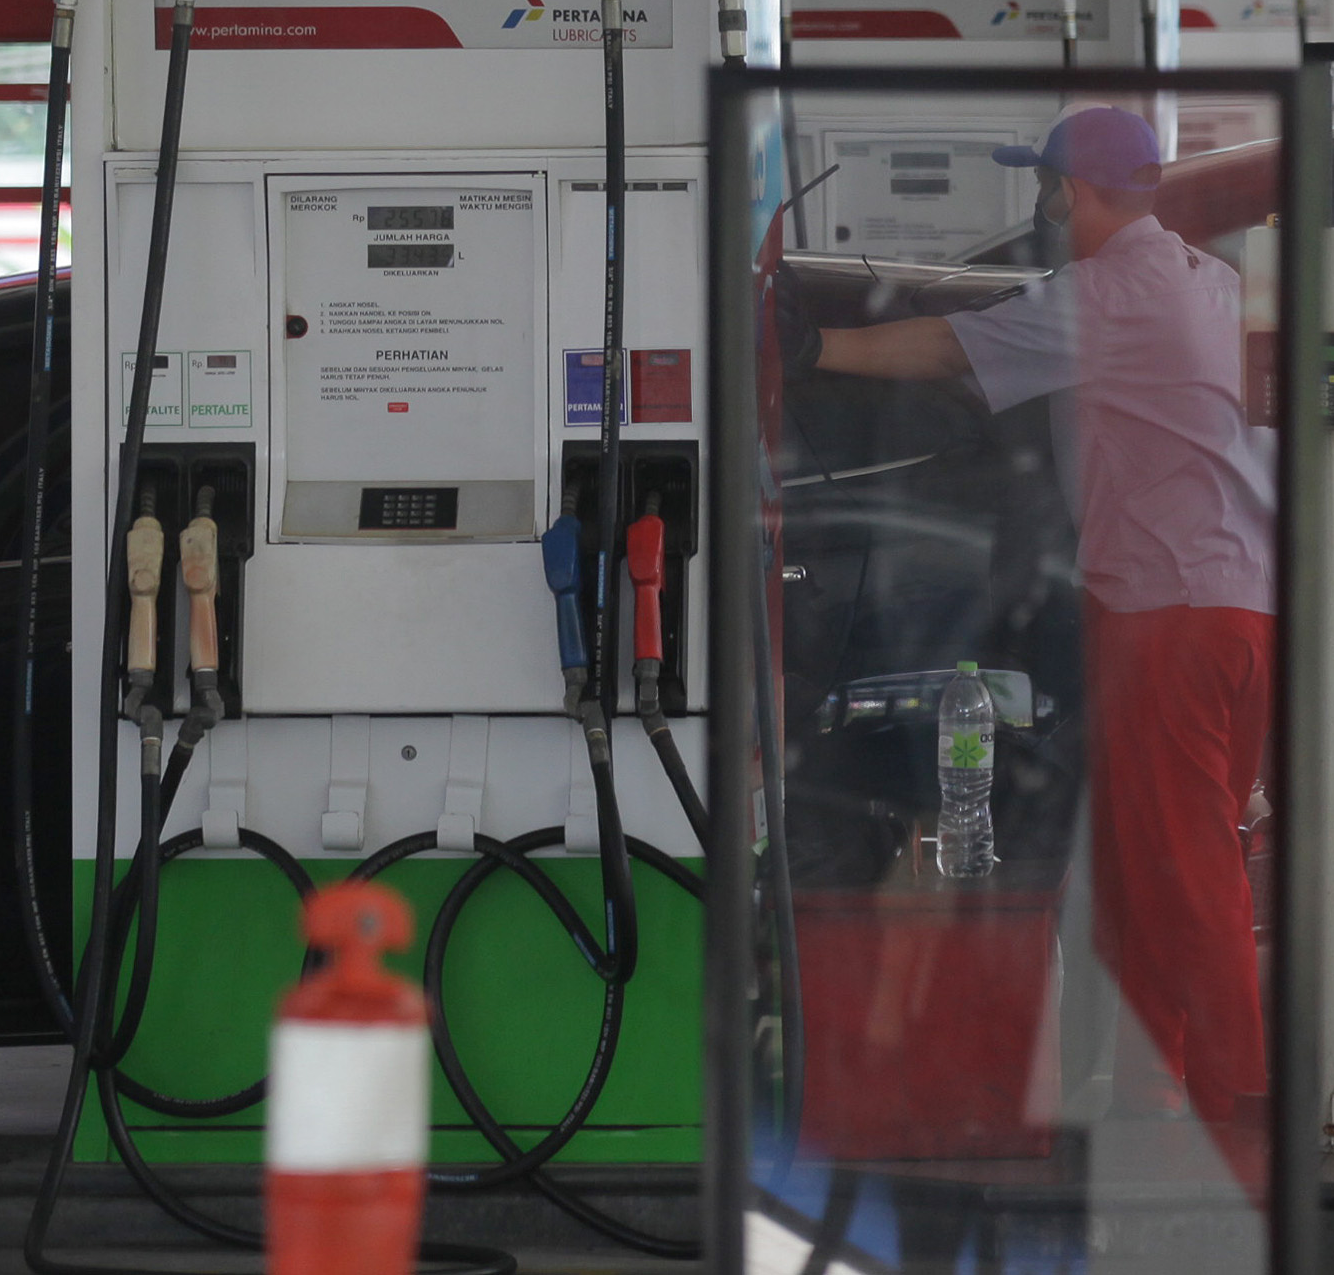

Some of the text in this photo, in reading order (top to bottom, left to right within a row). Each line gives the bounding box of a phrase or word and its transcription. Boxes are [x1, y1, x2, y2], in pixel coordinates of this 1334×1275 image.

[553, 10, 648, 22] PERTANA
[171, 24, 317, 39] w.pertamina.com
[553, 28, 637, 42] LUBRICATS
[352, 215, 365, 223] Rp
[376, 350, 448, 360] PERHATIAN
[192, 359, 203, 369] Rp
[126, 406, 180, 415] PTALITE
[191, 405, 249, 415] PERTALITE
[568, 403, 623, 412] PERTAM
